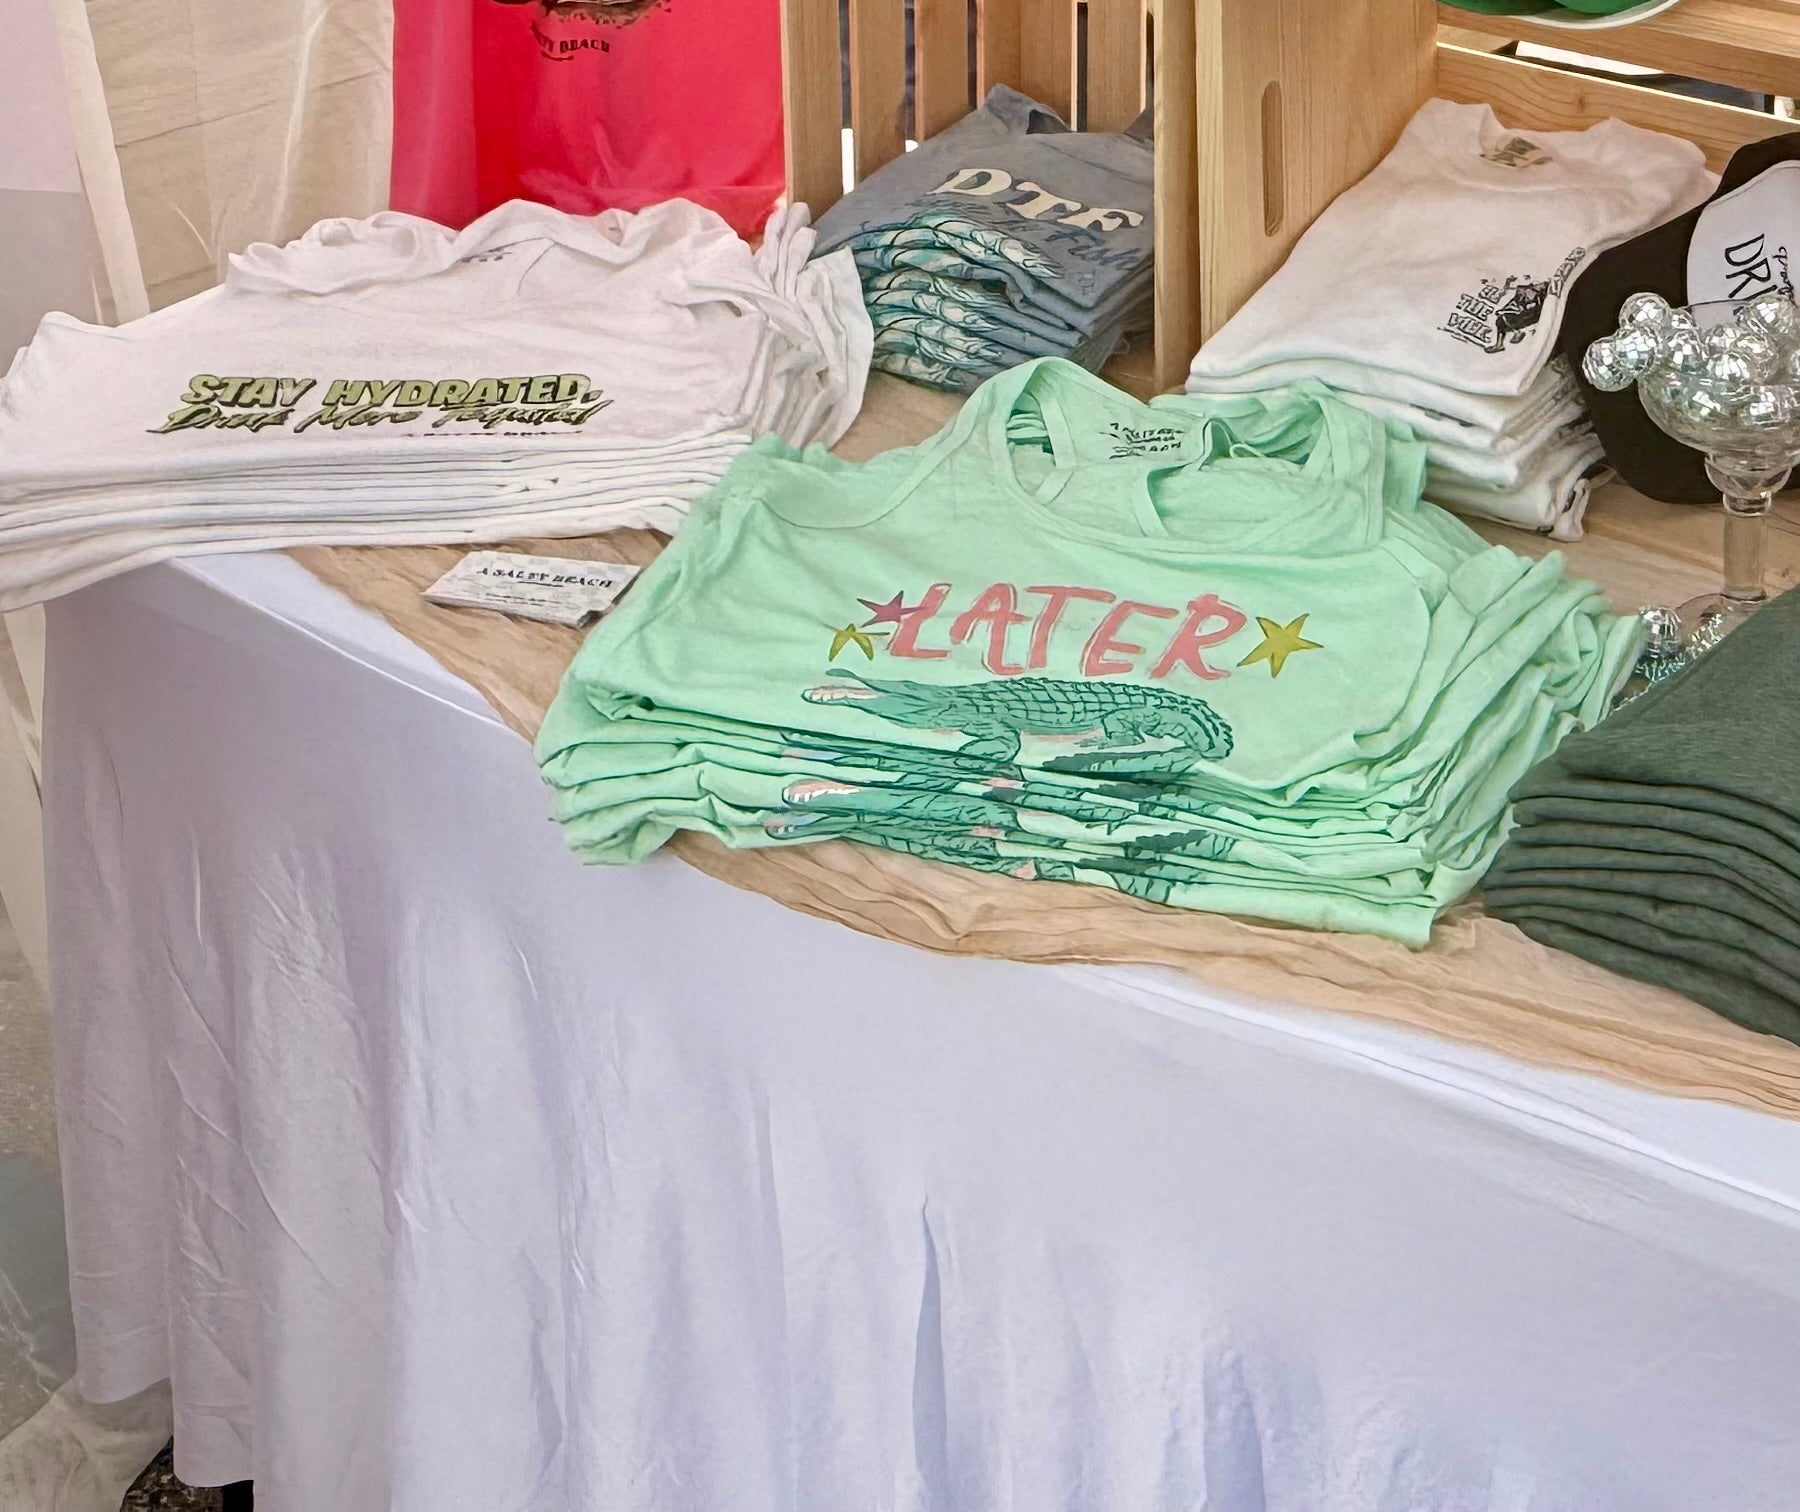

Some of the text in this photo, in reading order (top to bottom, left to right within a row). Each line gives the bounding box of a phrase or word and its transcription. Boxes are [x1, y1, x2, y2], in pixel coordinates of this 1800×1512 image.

[925, 168, 1145, 232] DTF
[180, 373, 604, 409] STAY HYDRATED,
[887, 582, 1250, 681] LATER
